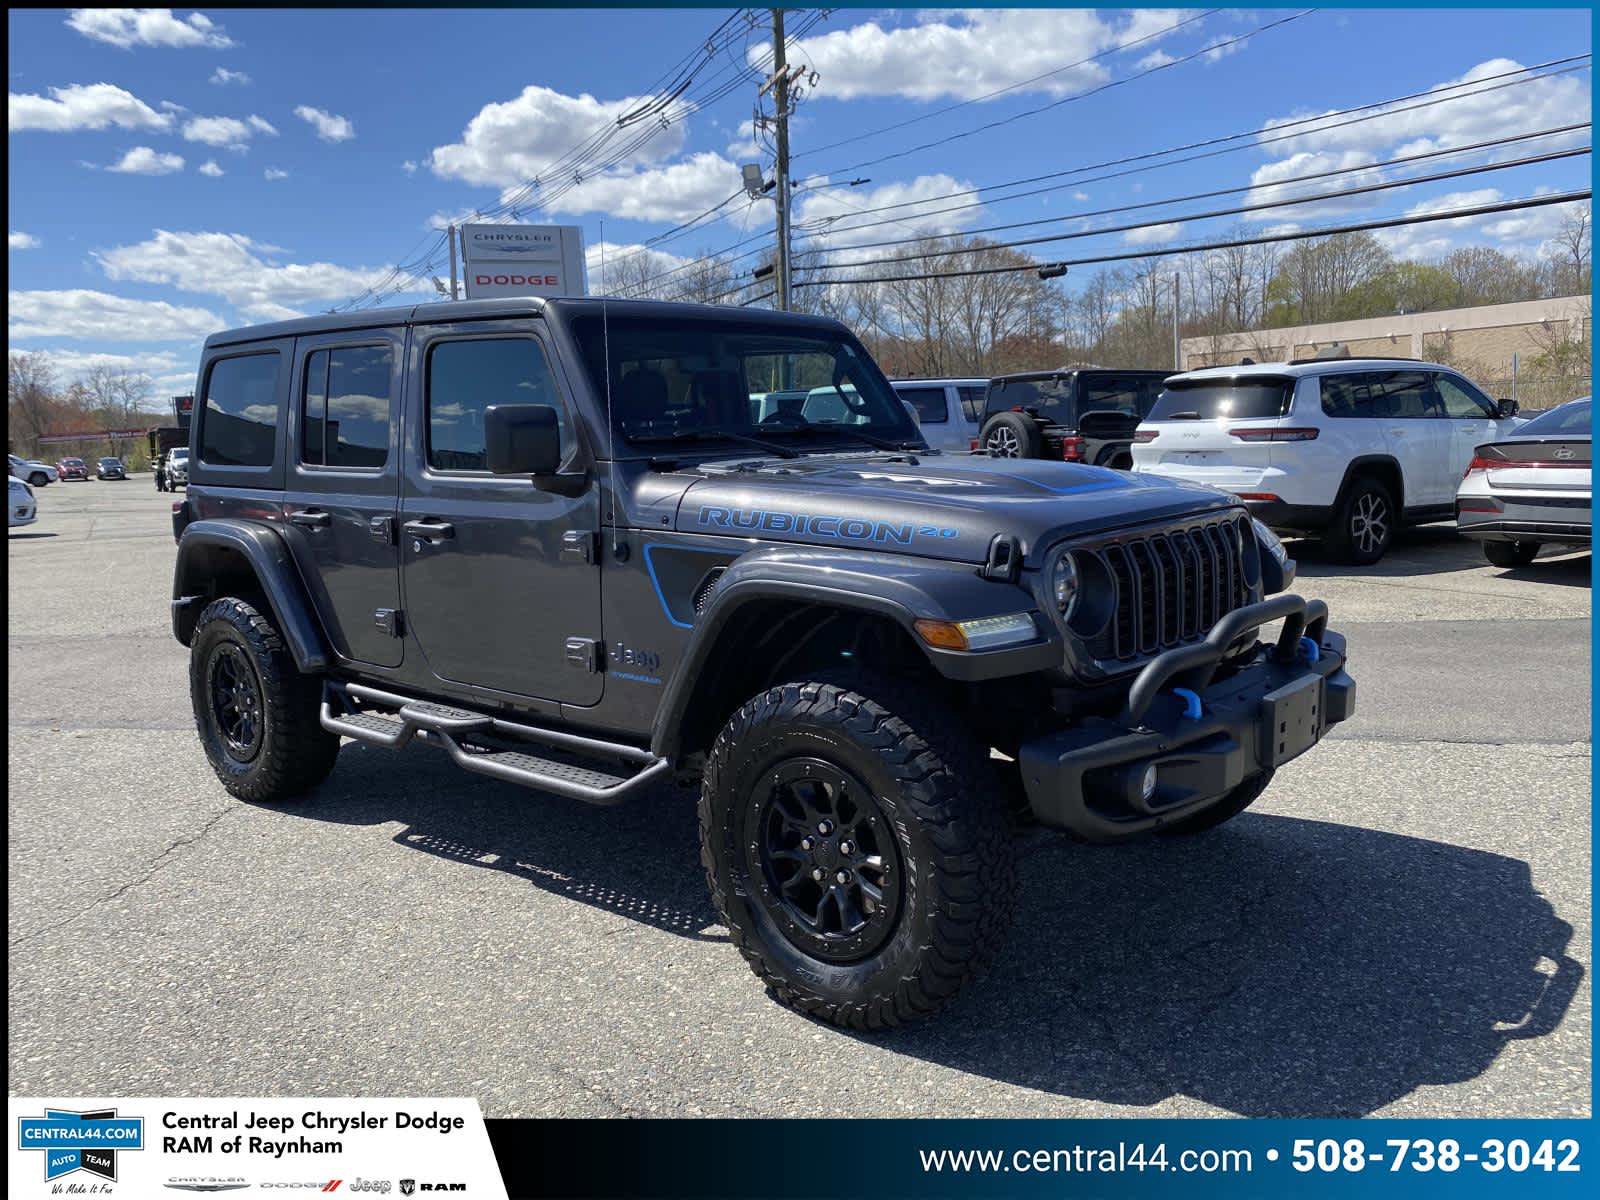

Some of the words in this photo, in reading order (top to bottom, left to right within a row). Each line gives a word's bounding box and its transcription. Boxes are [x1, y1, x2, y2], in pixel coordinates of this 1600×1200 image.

[474, 233, 552, 241] CHRYSLER
[475, 275, 558, 286] DODGE
[699, 506, 913, 545] RUBICON
[609, 641, 661, 670] Jeep
